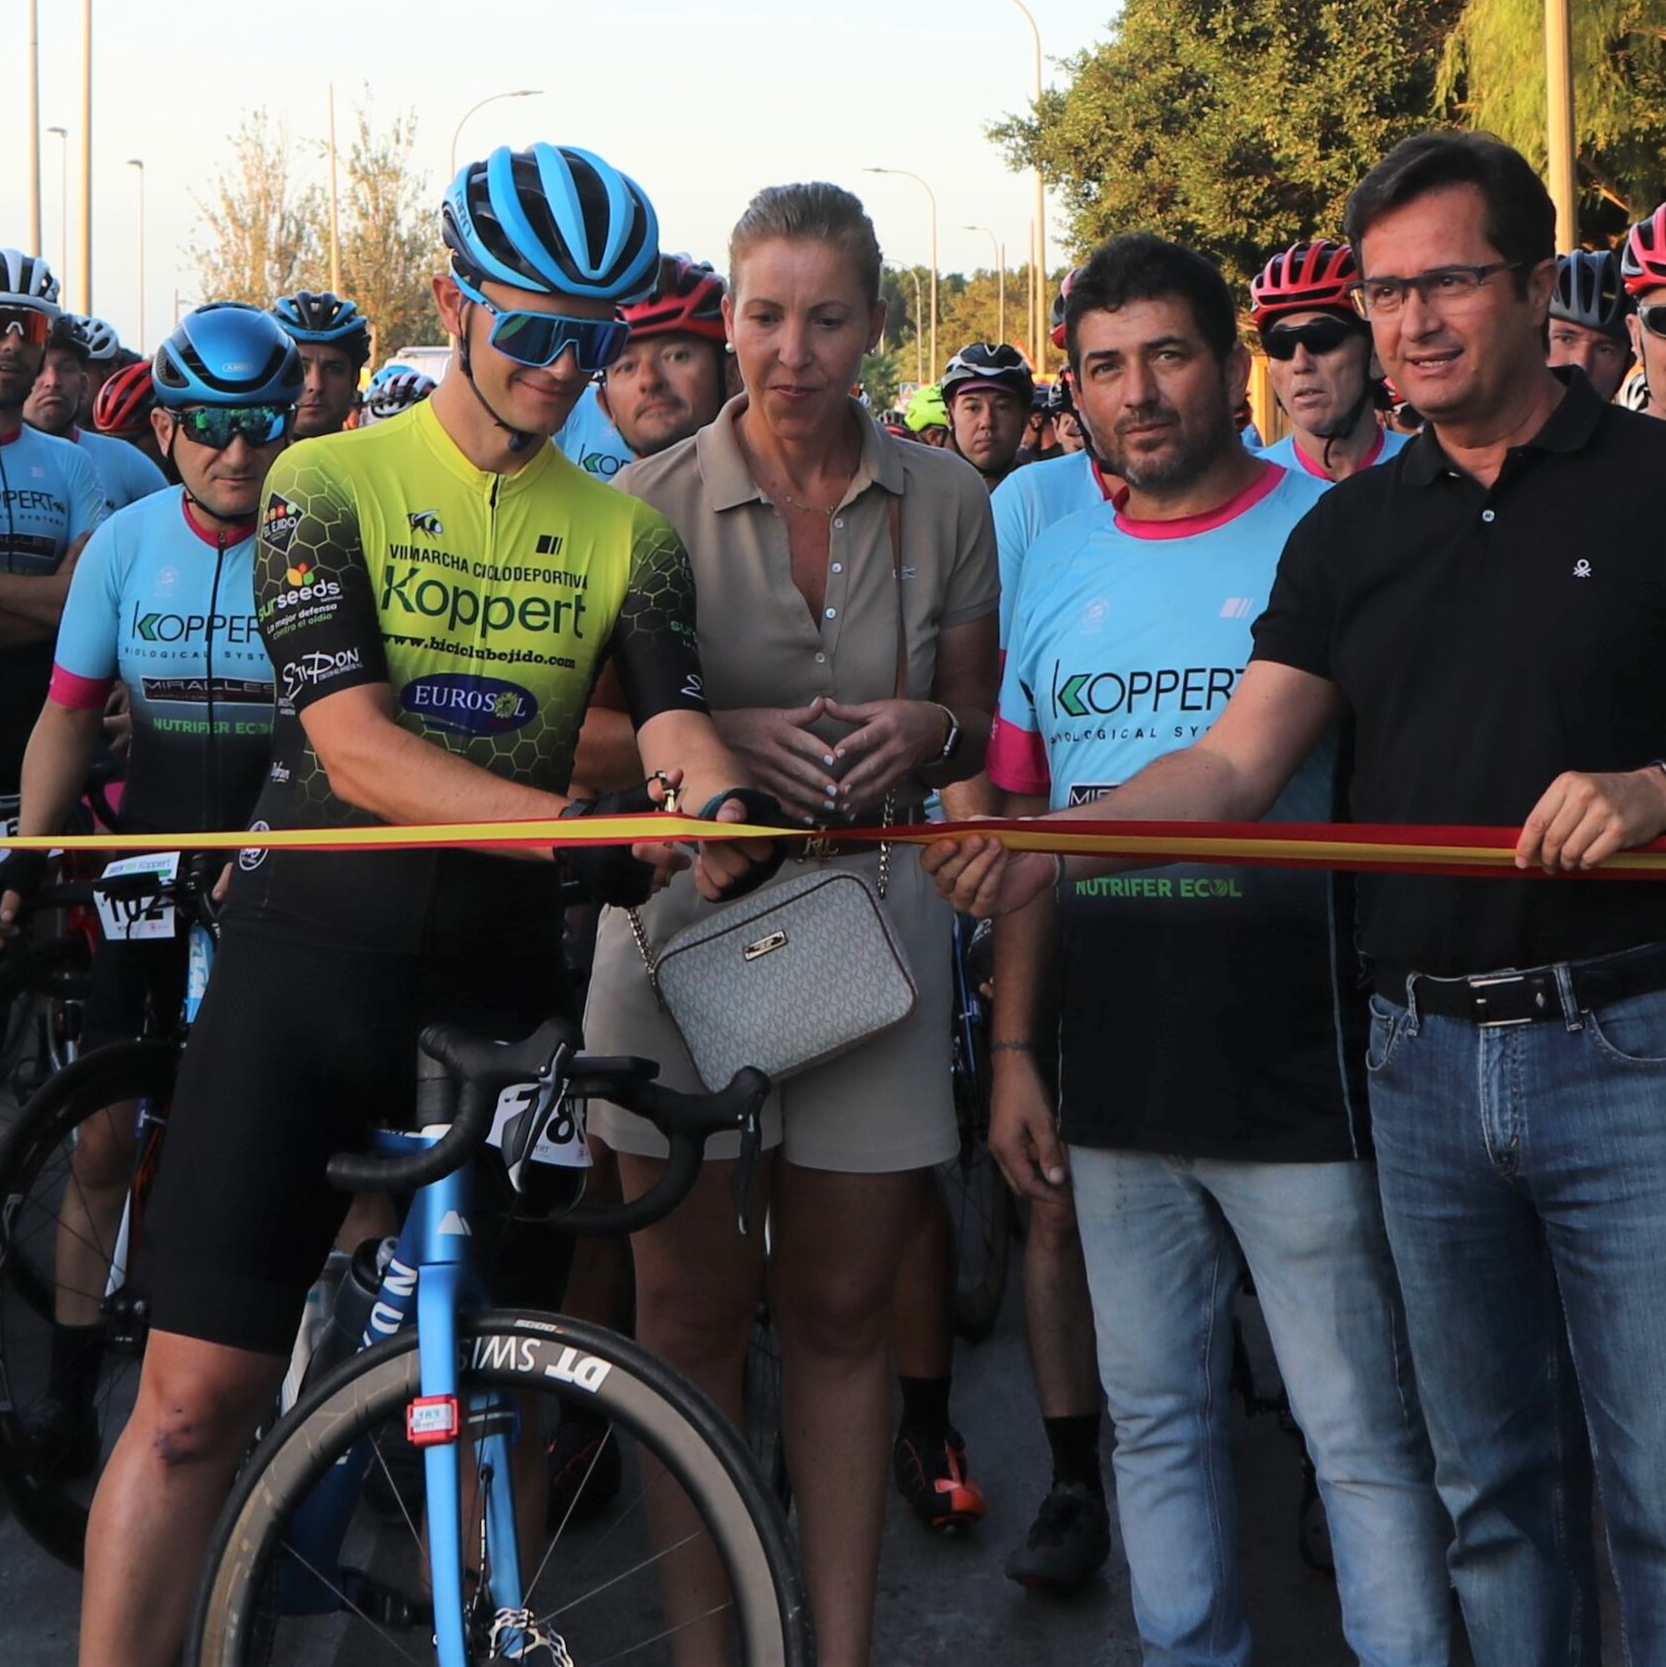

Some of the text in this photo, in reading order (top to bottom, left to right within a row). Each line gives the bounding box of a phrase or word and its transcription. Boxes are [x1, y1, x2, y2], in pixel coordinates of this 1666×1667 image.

[271, 516, 297, 533] EJIDO
[409, 545, 469, 574] MARCHA
[473, 561, 588, 591] CICLODEPORTIVA
[132, 600, 260, 644] KOPPER
[258, 579, 341, 623] surseeds
[275, 612, 297, 629] mejor
[298, 603, 338, 619] defensa
[380, 564, 587, 639] Koppert
[224, 651, 266, 661] SYST
[1052, 658, 1245, 719] KOPPER
[153, 718, 230, 734] NUTRIFER
[1075, 876, 1173, 898] NUTRIFER
[544, 1345, 613, 1394] DT
